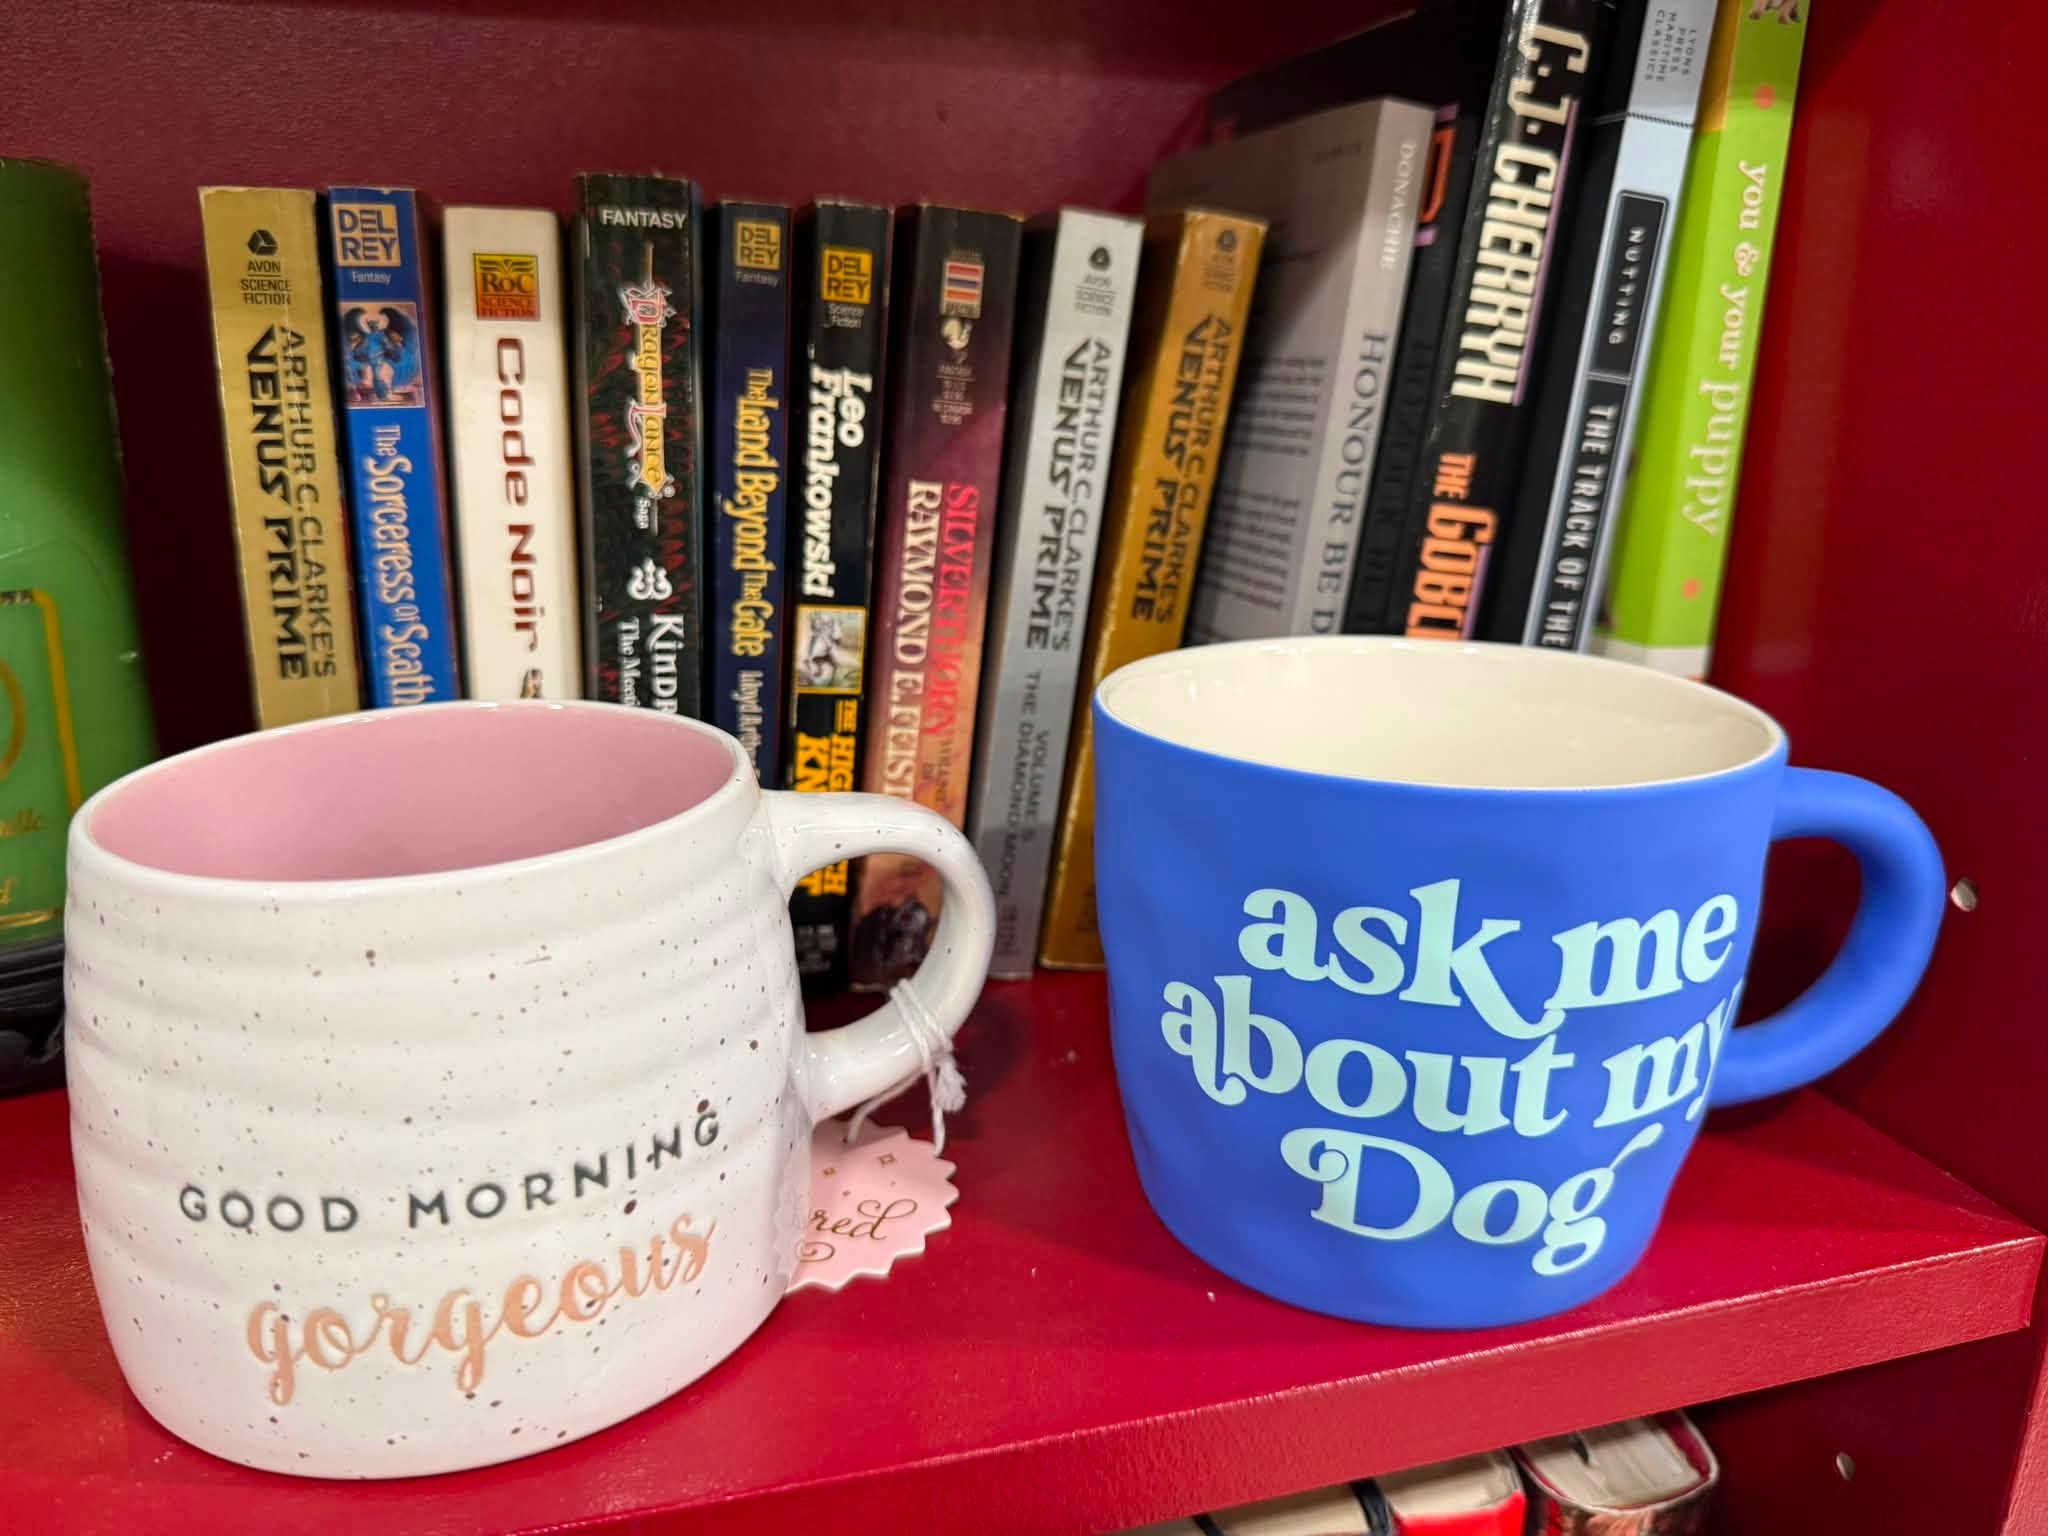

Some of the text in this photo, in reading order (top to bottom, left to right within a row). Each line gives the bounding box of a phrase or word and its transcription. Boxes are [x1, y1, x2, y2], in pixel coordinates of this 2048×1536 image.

[248, 260, 281, 273] AVON
[338, 209, 396, 234] DEL
[340, 237, 397, 261] REY
[351, 271, 391, 285] Fantasy
[602, 208, 687, 229] FANTASY
[740, 246, 778, 265] REY
[741, 225, 778, 246] DEL
[828, 254, 869, 277] DEL
[1451, 142, 1558, 404] CHERRYH
[241, 279, 291, 292] SCIENCE
[244, 292, 291, 305] FICTION
[826, 277, 869, 299] REY
[1608, 226, 1647, 346] NUTTING
[745, 368, 774, 399] The
[837, 368, 873, 448] Leo
[1077, 336, 1111, 478] ARTHUR
[1192, 315, 1233, 449] ARTHUR
[1682, 161, 1767, 536] you & your puppy
[735, 396, 780, 469] Land
[801, 362, 842, 599] Frankowski
[1130, 314, 1215, 622] VENUS PRIME
[1330, 330, 1388, 526] HONOUR
[1434, 451, 1478, 500] THE
[247, 323, 309, 680] VENUS PRIME
[280, 325, 316, 475] ARTHUR
[299, 516, 336, 678] CLARKE'S
[365, 456, 413, 605] Sorceress
[497, 337, 545, 652] Code Noir
[723, 471, 780, 572] Beyond
[1026, 336, 1092, 651] VENUS PRIME
[1543, 404, 1619, 648] THE TRACK OF THE
[731, 599, 775, 657] Gate
[896, 480, 943, 664] RAYMOND
[923, 482, 980, 737] SILVERTHORN
[1052, 505, 1088, 653] CLARKE'S
[1317, 542, 1349, 595] BE
[1406, 504, 1498, 640] GOBL
[381, 622, 436, 706] Scath
[618, 615, 641, 657] The
[1237, 878, 1739, 1040] ask me
[1160, 974, 1744, 1137] about my
[179, 1110, 721, 1233] GOOD MORNING
[1279, 1122, 1665, 1276] Dog
[246, 1212, 717, 1406] gorgeous
